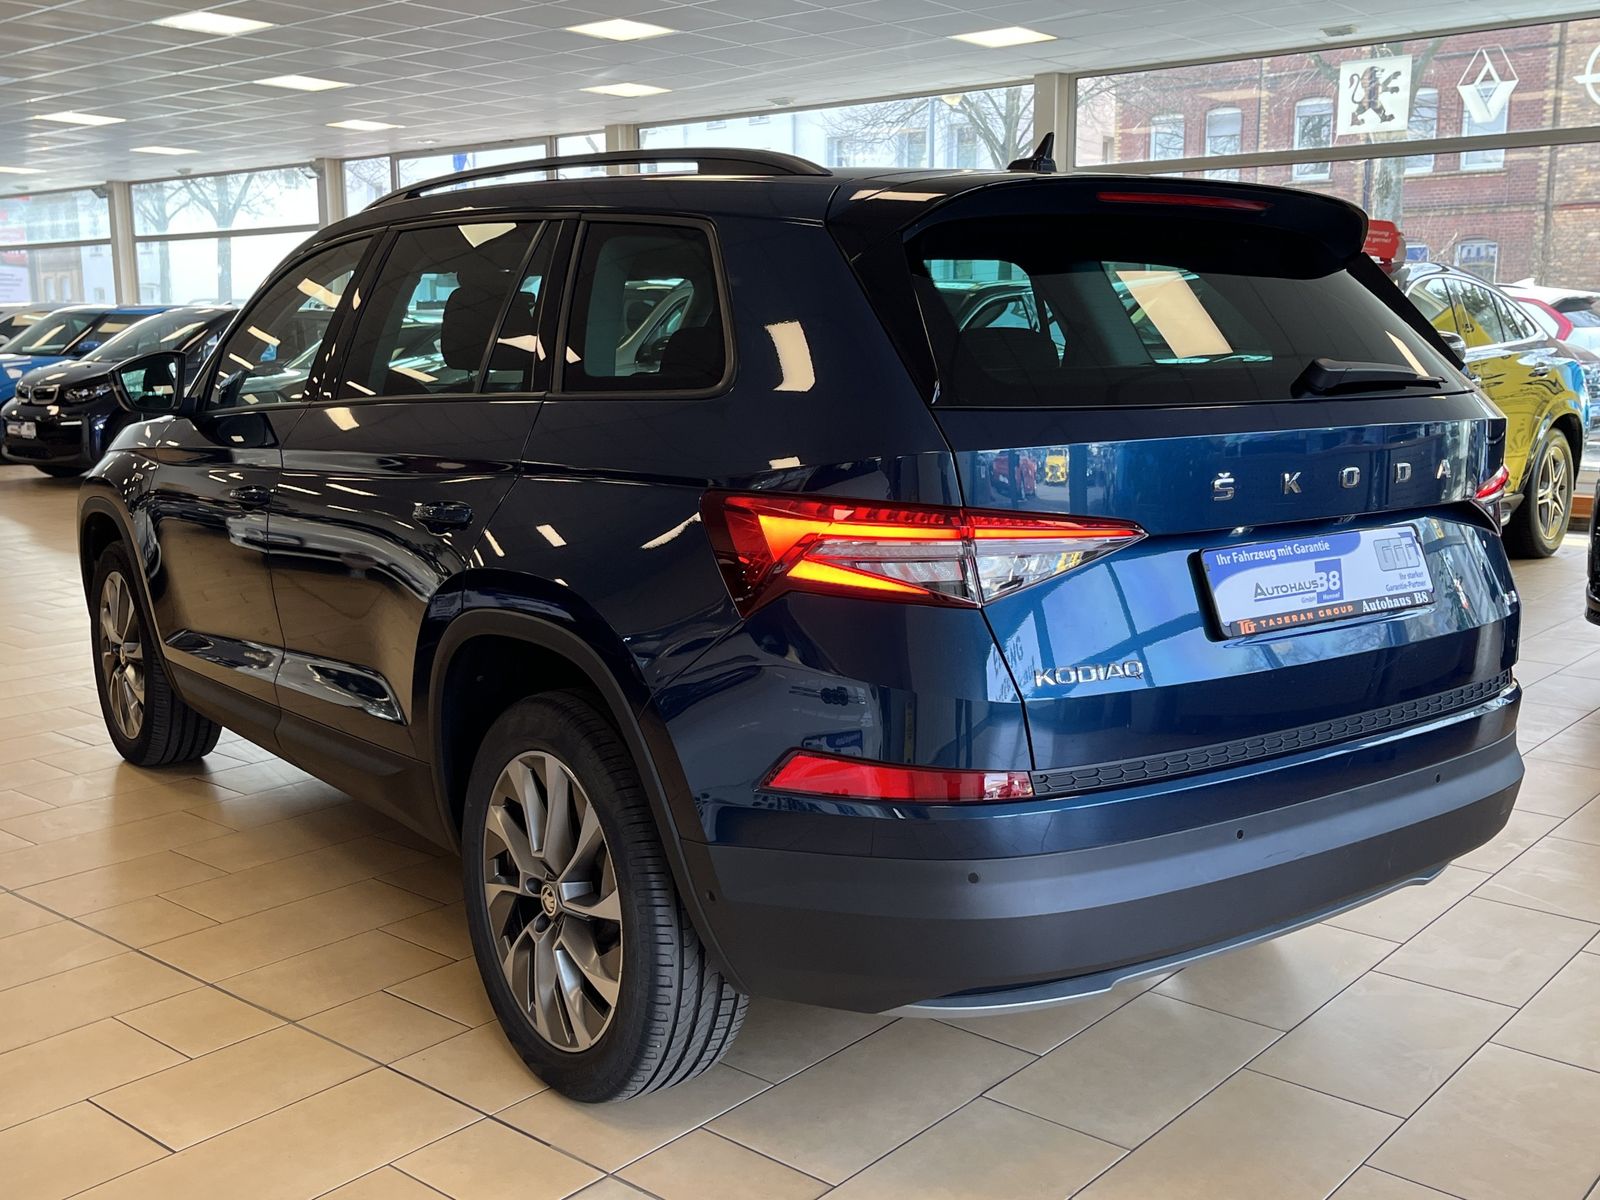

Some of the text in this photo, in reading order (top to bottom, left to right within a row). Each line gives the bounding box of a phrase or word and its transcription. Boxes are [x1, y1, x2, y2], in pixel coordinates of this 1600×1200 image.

[1216, 540, 1330, 565] Ihr Fahrzeug mit Garantie
[1314, 570, 1340, 593] B8
[1362, 591, 1429, 613] Autohaus B8
[1259, 611, 1314, 628] TAJERAN
[1318, 604, 1354, 618] GROUP
[1034, 660, 1144, 687] KODIAQ
